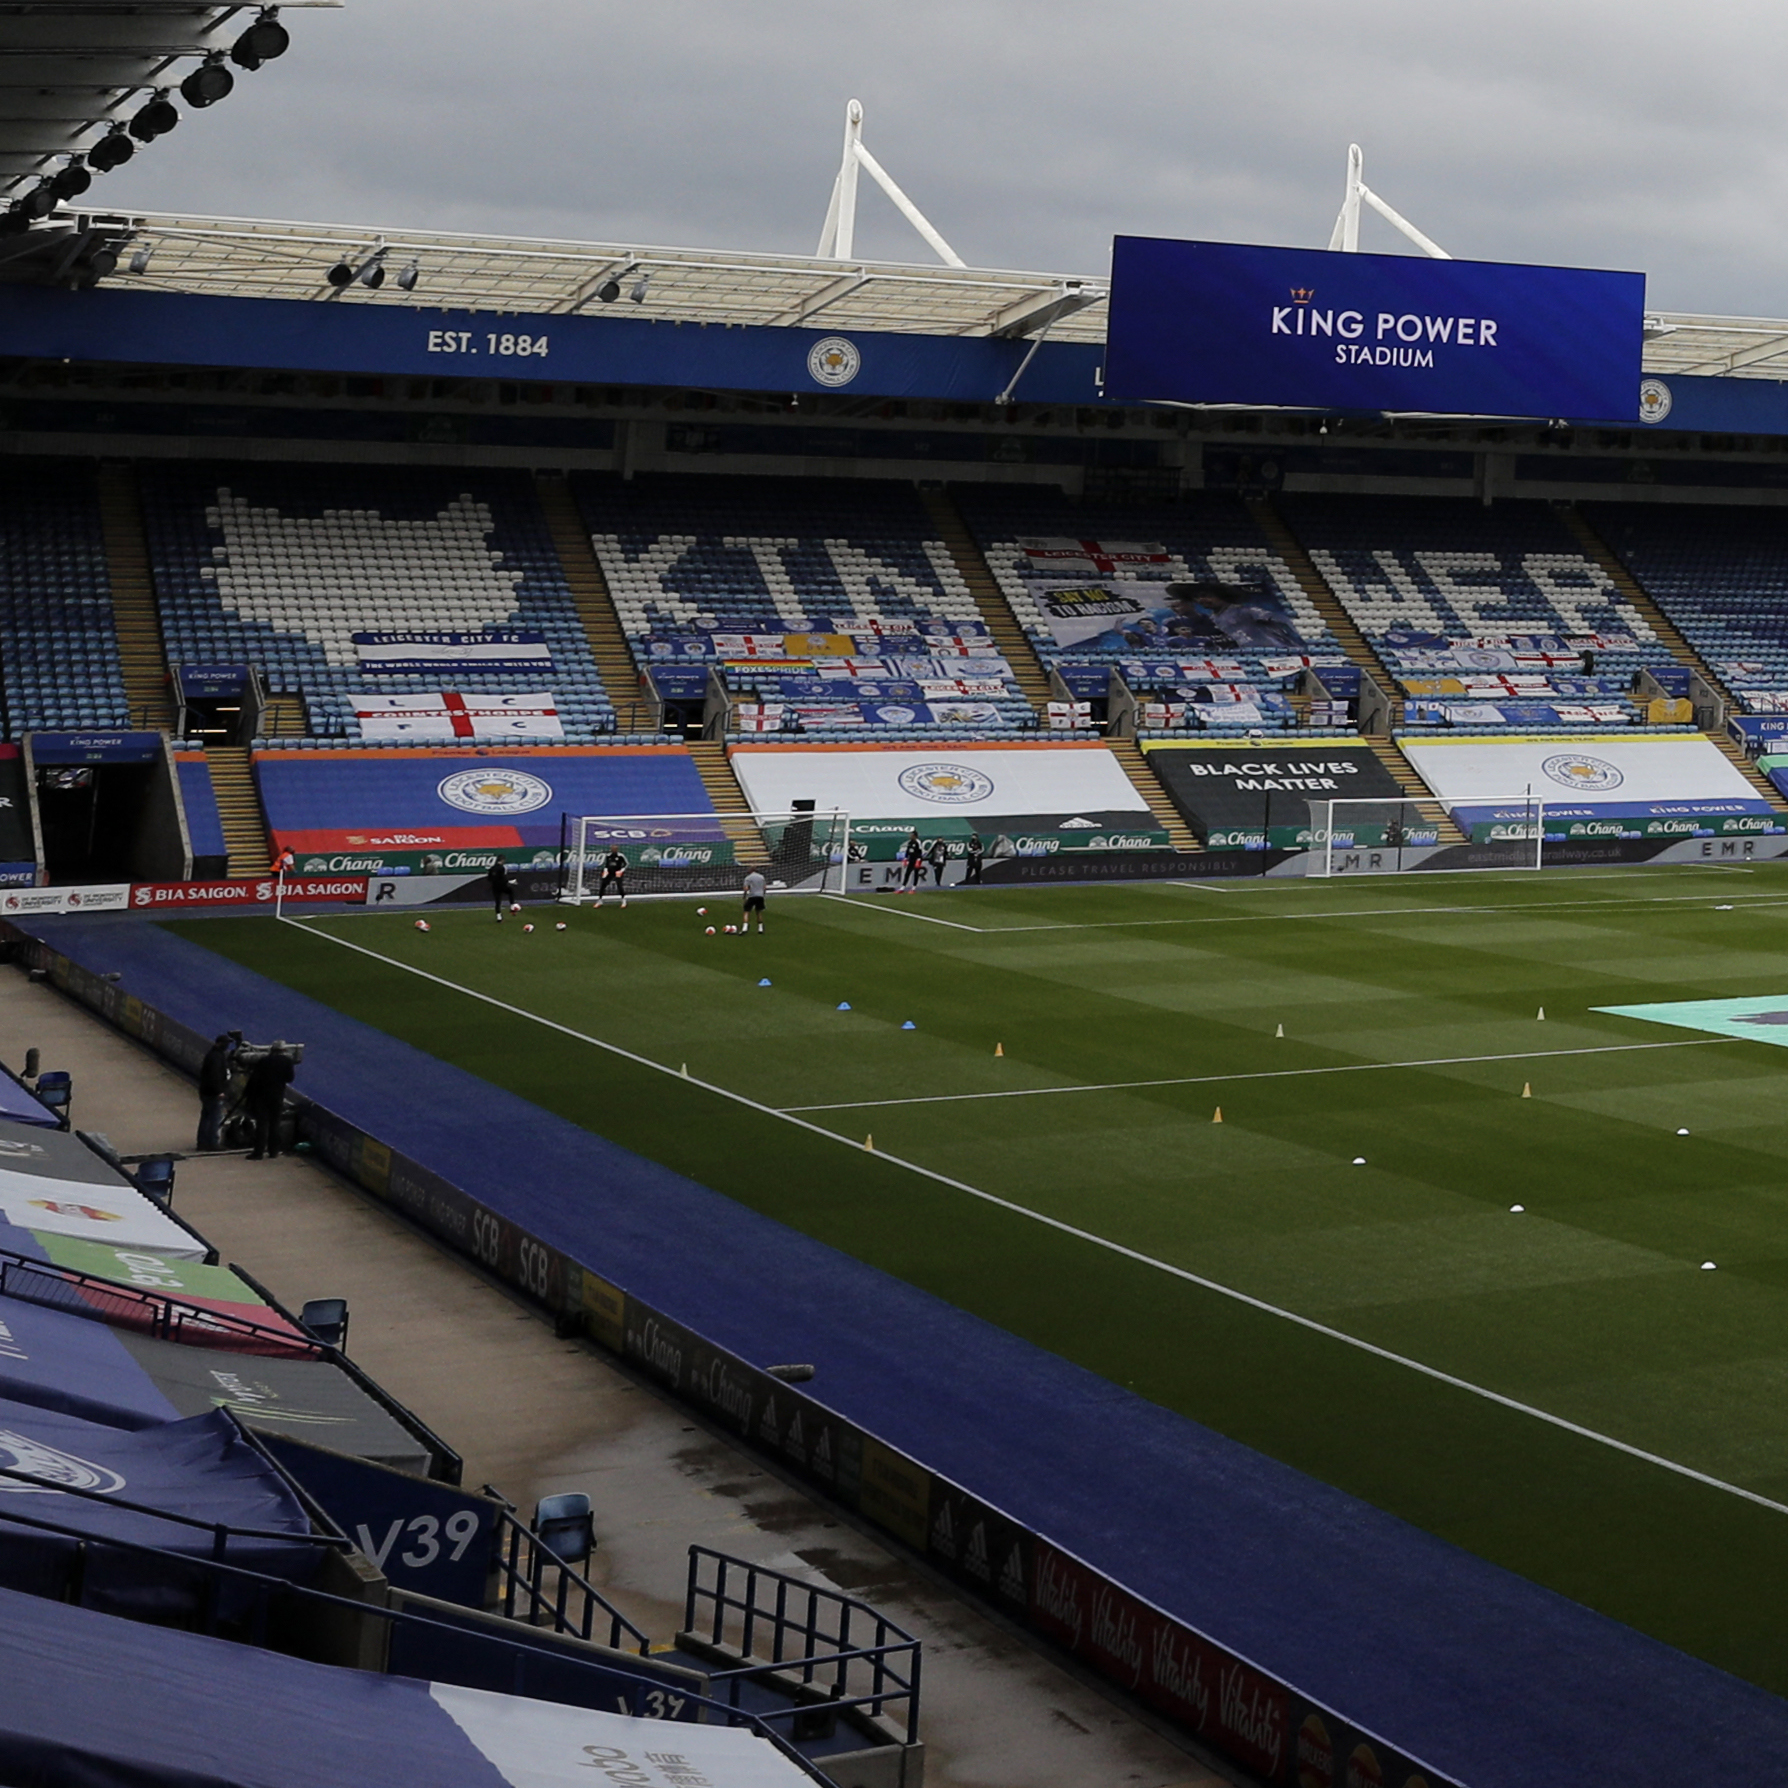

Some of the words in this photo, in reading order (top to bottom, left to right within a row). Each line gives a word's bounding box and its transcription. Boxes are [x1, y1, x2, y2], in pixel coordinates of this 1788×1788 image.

[1272, 307, 1363, 339] KING
[1376, 313, 1498, 347] POWER
[427, 331, 477, 354] EST.
[485, 333, 549, 358] 1884
[1335, 345, 1435, 369] STADIUM
[1044, 550, 1117, 561] LEICESTER
[1120, 553, 1151, 562] CITY
[1054, 591, 1085, 603] SAY
[1087, 589, 1110, 600] NO
[1051, 604, 1072, 616] TO
[1075, 601, 1137, 615] RACISM
[373, 635, 451, 643] LEICESTER
[461, 634, 493, 643] CITY
[502, 634, 519, 642] FC
[1760, 721, 1784, 731] KING
[1190, 762, 1282, 776] BLACK
[1286, 761, 1359, 775] LIVES
[1235, 779, 1339, 792] MATTER
[594, 830, 647, 838] SCB
[1015, 836, 1060, 852] Chang
[1703, 840, 1755, 856] EMR
[663, 847, 713, 863] Chang
[329, 857, 384, 873] Chang
[1021, 864, 1074, 877] PLEASE
[1082, 862, 1134, 875] TRAVEL
[1141, 859, 1238, 873] RESPONSIBLY
[155, 889, 188, 902] BIA
[472, 1209, 500, 1266] SCB
[519, 1236, 548, 1298] SCB
[642, 1317, 682, 1388] Chang
[709, 1357, 753, 1434] Chang
[356, 1509, 479, 1573] V39
[1035, 1549, 1084, 1650] Vitality
[1091, 1585, 1142, 1690] Vitality
[1152, 1624, 1208, 1731] Vitality
[1219, 1663, 1281, 1778] Vitality
